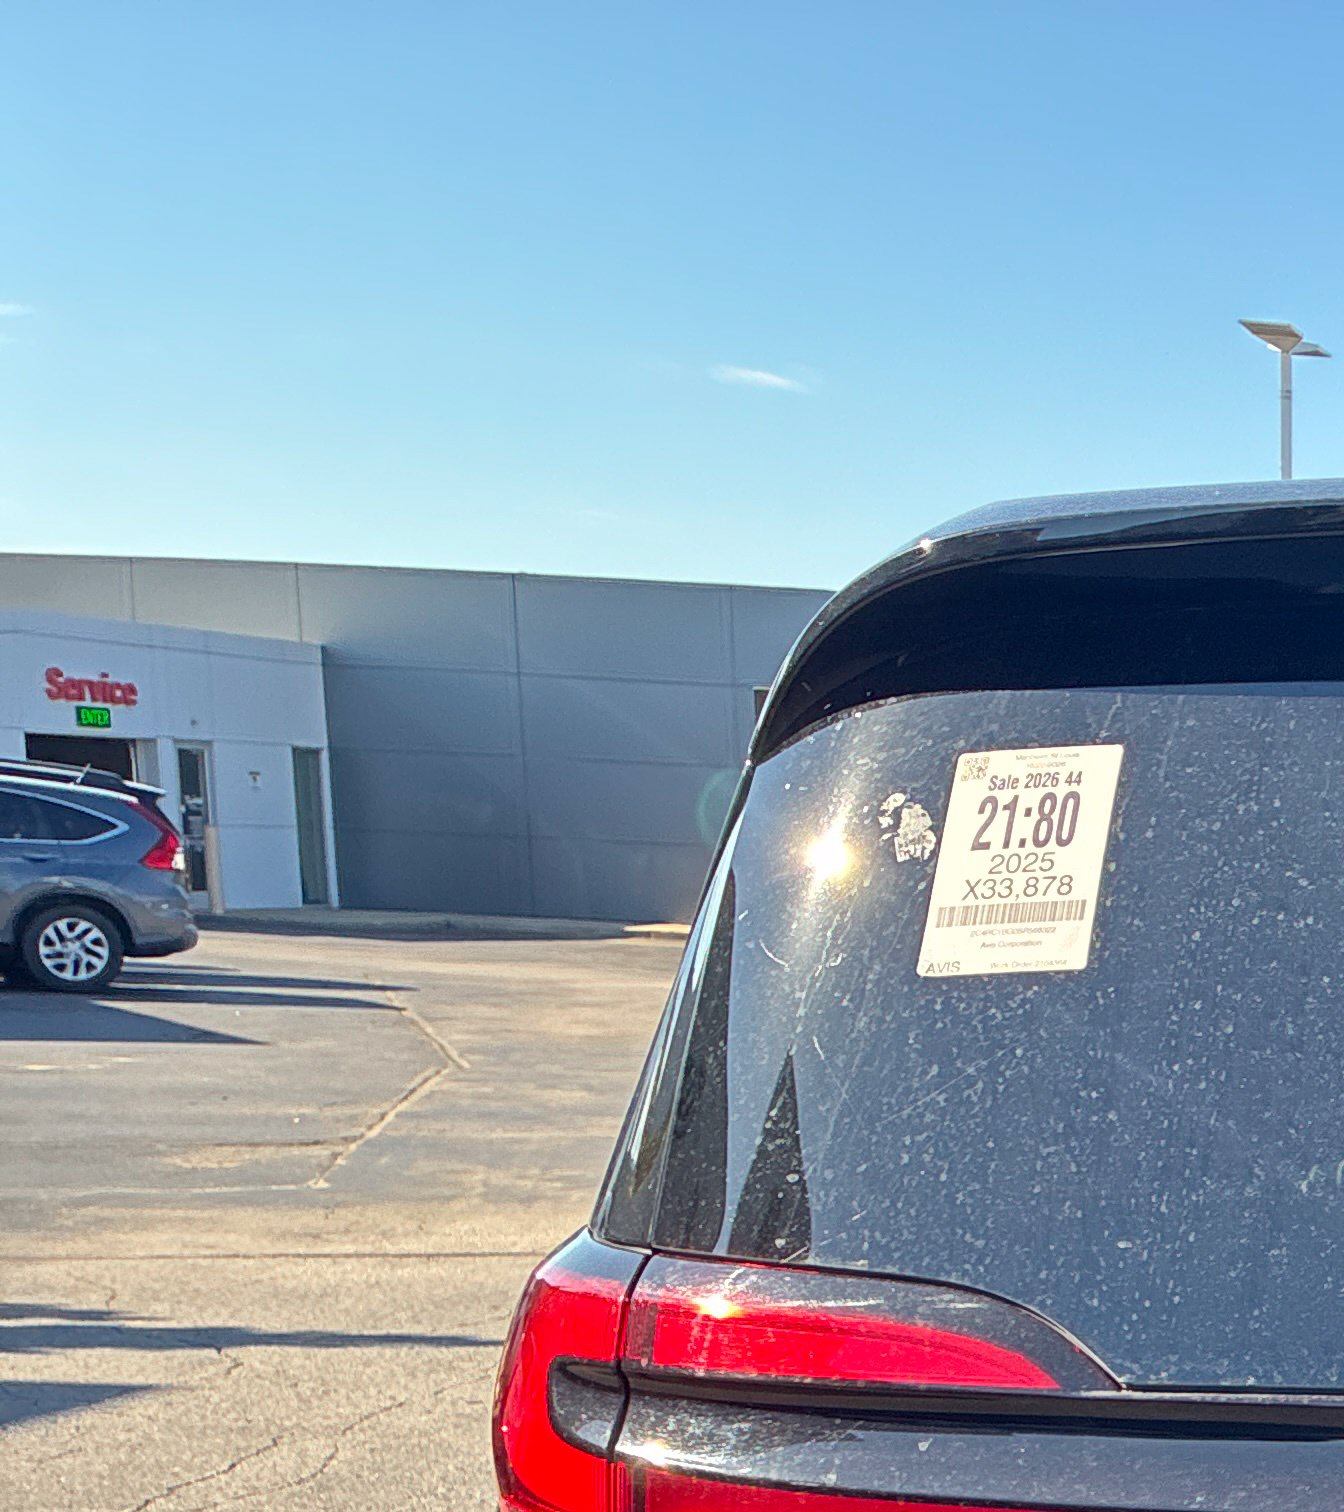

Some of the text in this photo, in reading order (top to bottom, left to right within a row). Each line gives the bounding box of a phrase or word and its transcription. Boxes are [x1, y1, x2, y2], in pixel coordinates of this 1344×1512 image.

[45, 667, 138, 706] Service
[988, 771, 1083, 791] Sale 2026 44
[970, 790, 1081, 851] 21:80
[988, 852, 1056, 875] 2025
[961, 874, 1074, 902] X33,878
[925, 960, 961, 975] AVIS
